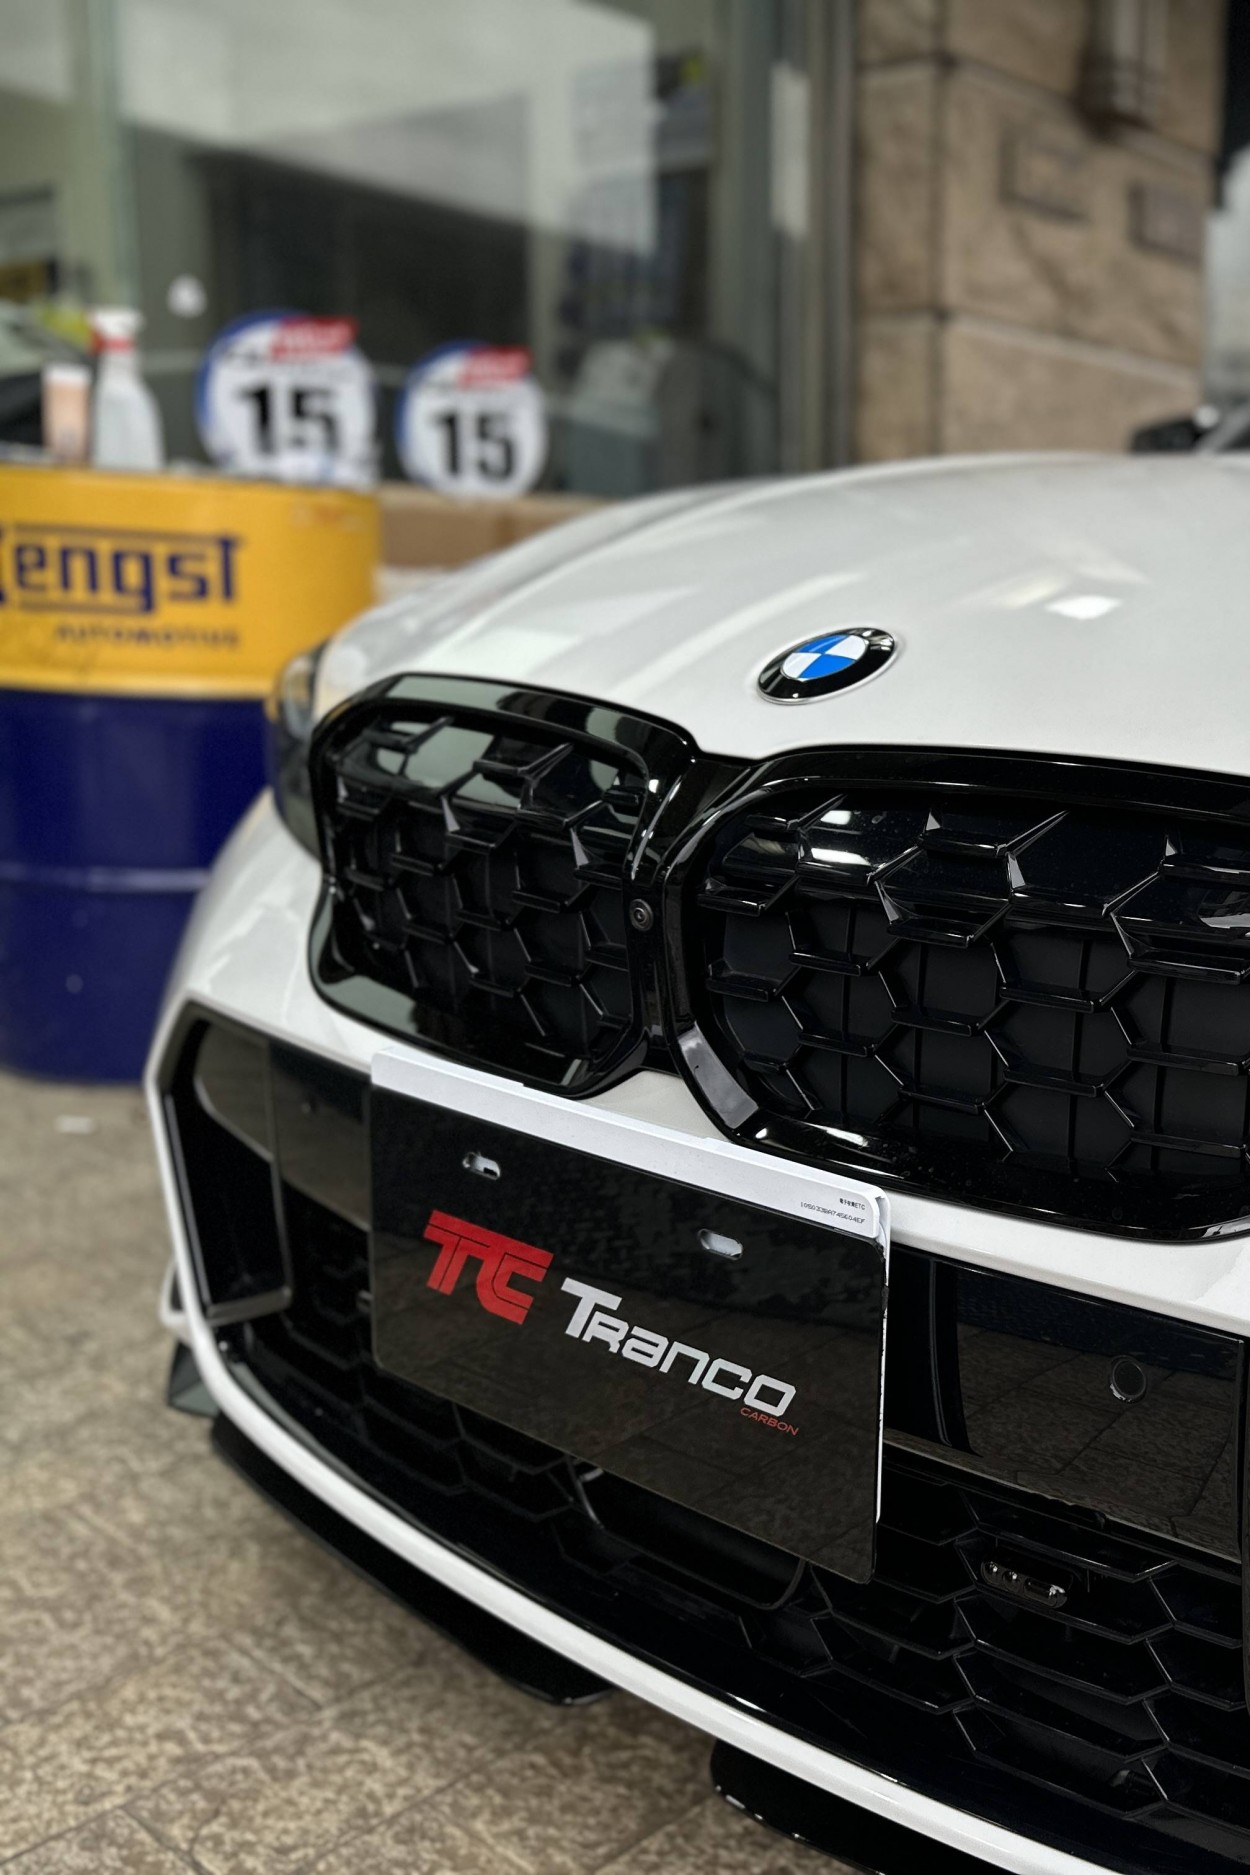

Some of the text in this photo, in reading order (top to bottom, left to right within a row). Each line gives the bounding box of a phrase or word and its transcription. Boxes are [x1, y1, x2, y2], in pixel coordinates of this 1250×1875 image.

[236, 382, 339, 459] 15
[432, 409, 516, 482] 15
[0, 521, 242, 613] engst
[740, 1407, 799, 1436] CARBON
